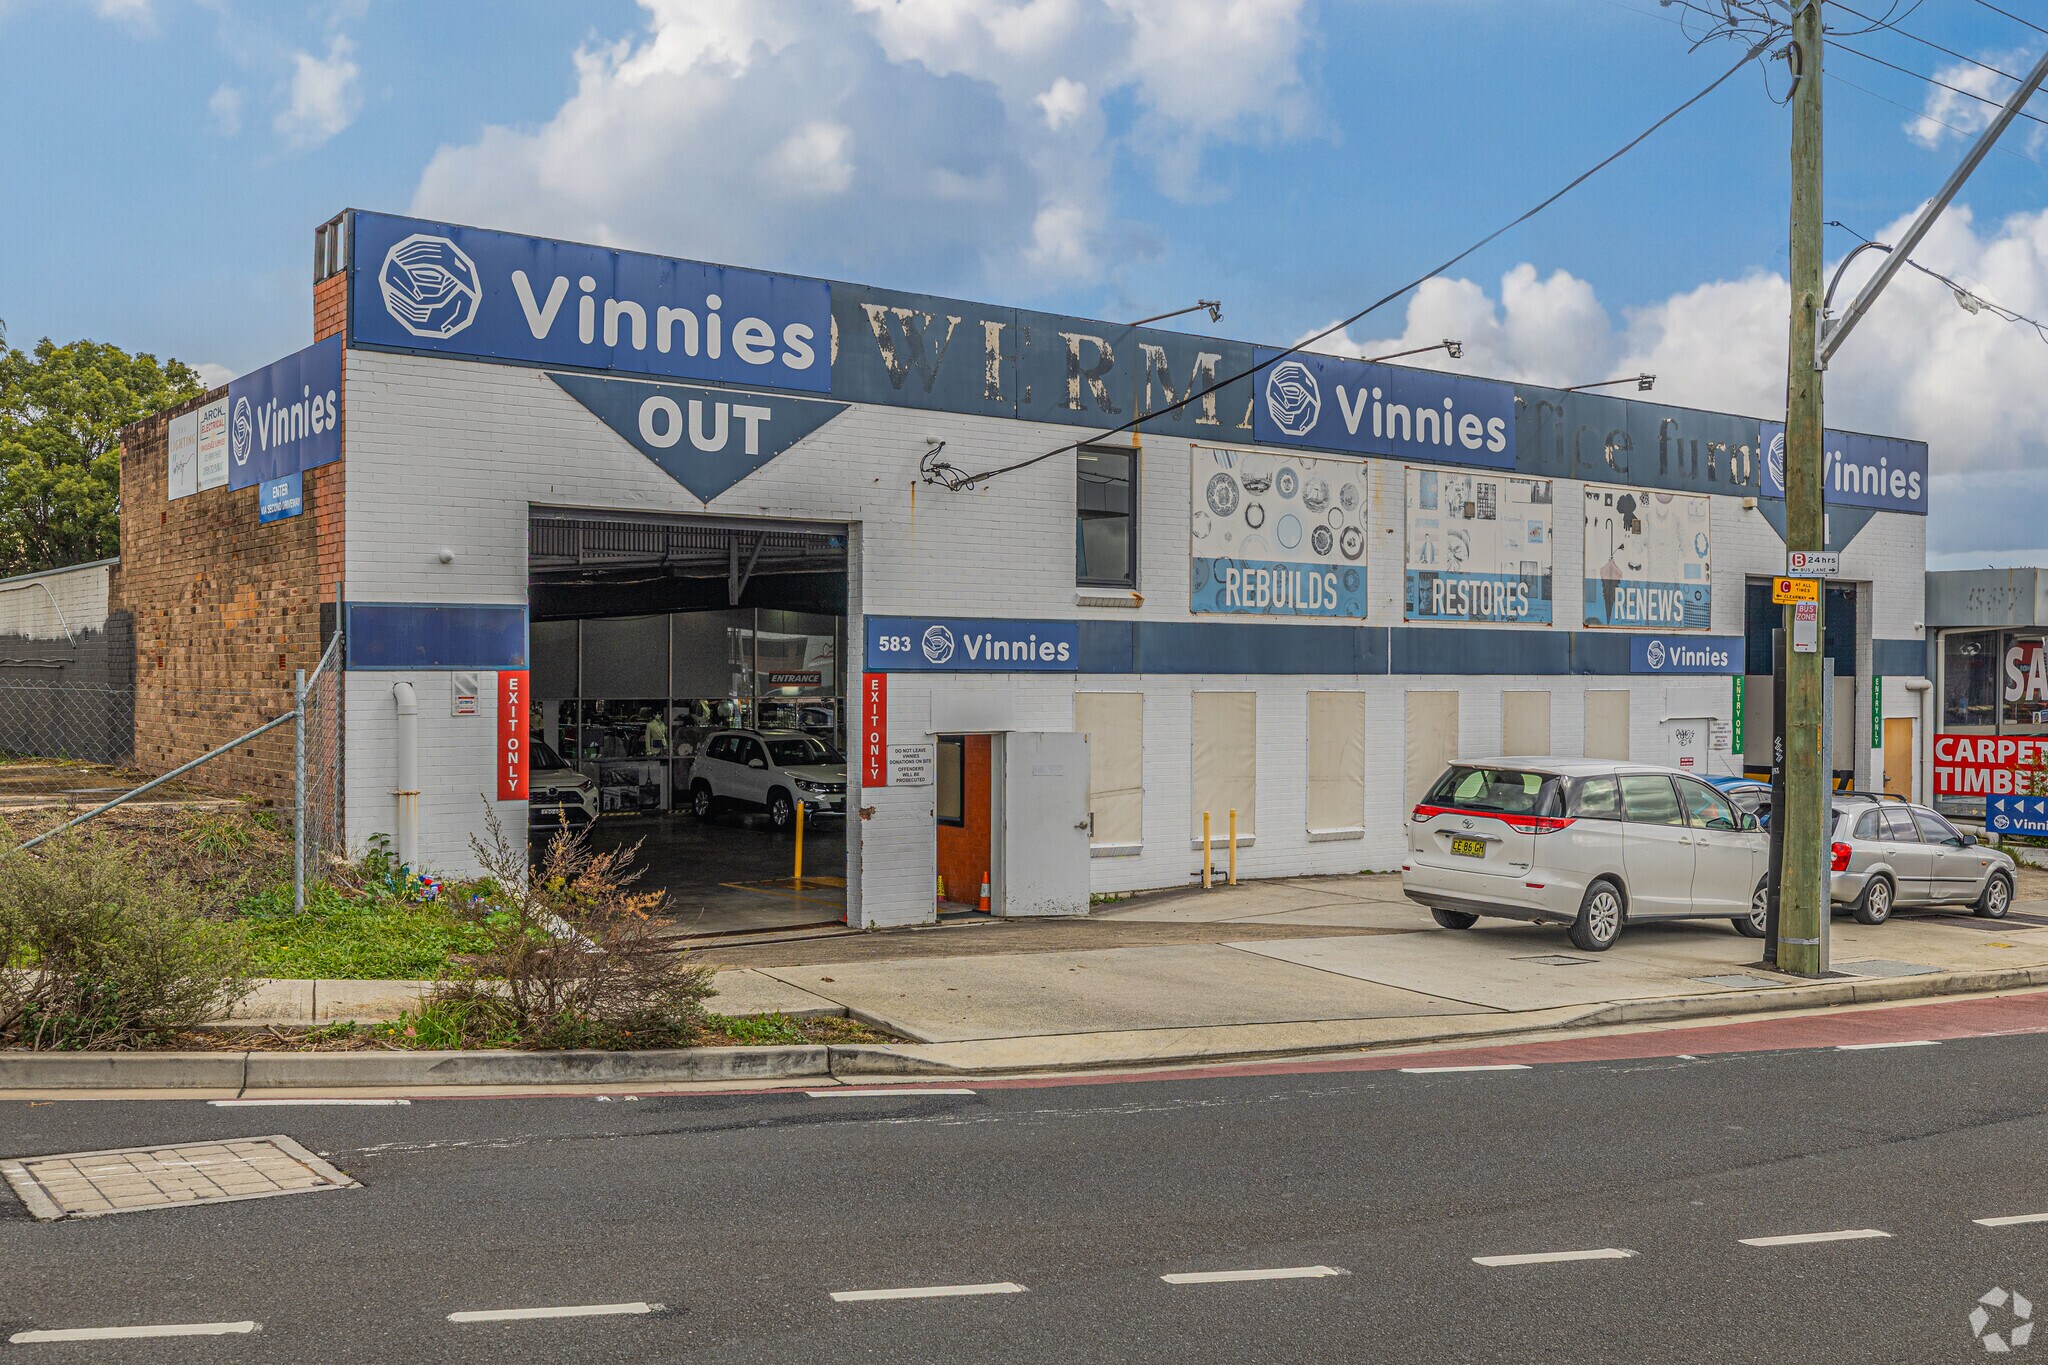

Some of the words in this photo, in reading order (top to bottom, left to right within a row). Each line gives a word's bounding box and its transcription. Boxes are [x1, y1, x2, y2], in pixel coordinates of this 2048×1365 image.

[511, 270, 815, 370] Vinnies
[201, 419, 224, 433] ELECTRICAL
[203, 406, 225, 422] ARCK
[257, 385, 336, 451] Vinnies
[638, 396, 771, 456] OUT
[1335, 385, 1506, 452] Vinnies
[170, 434, 196, 453] LIGHTING
[272, 483, 288, 498] ENTER
[1794, 553, 1804, 567] B
[1808, 556, 1836, 564] 24hrs
[1225, 567, 1337, 610] REBUILDS
[1432, 578, 1529, 616] RESTORES
[1614, 587, 1684, 622] RENEWS
[1782, 581, 1789, 592] C
[879, 636, 911, 652] 583
[963, 633, 1070, 661] Vinnies
[1669, 646, 1729, 667] Vinnies
[771, 674, 819, 683] ENTRANCE
[508, 678, 519, 731] EXIT
[871, 679, 879, 727] EXIT
[507, 738, 519, 791] ONLY
[870, 733, 879, 780] ONLY
